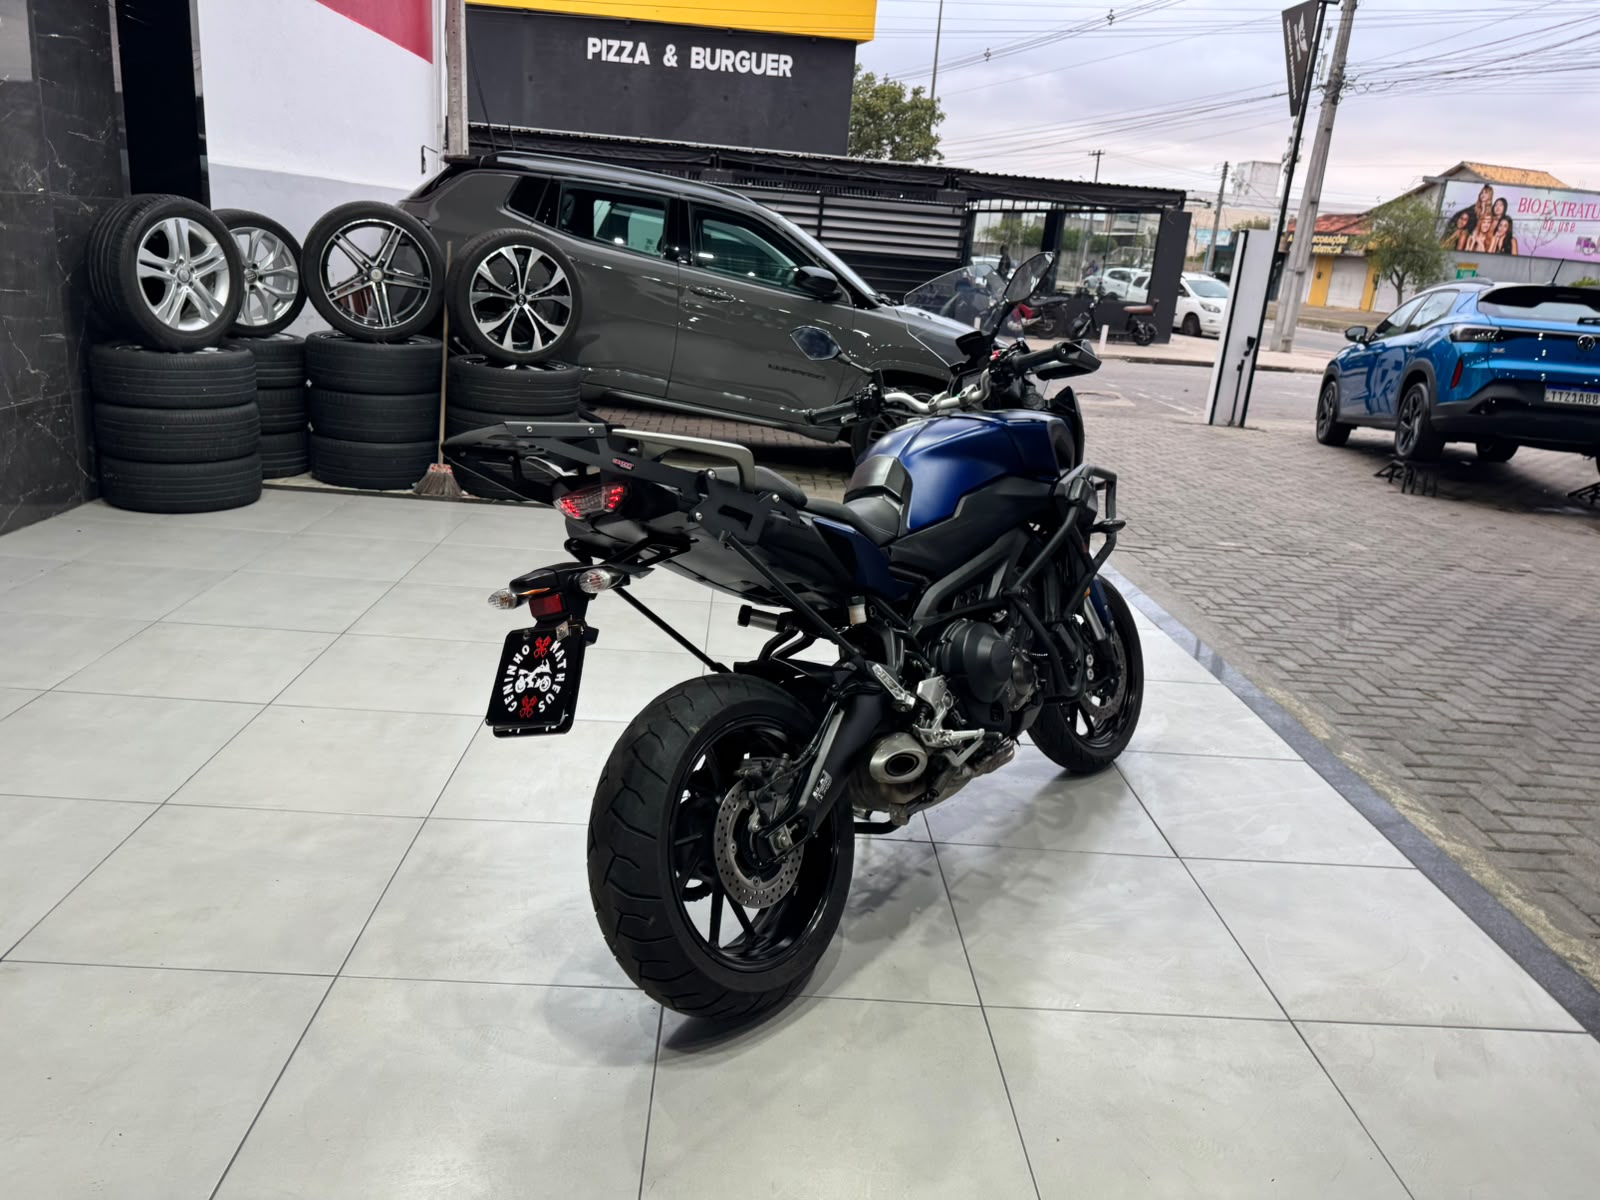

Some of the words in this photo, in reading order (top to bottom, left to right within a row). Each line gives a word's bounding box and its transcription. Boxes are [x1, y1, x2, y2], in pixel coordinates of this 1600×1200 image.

[587, 37, 650, 65] PIZZA
[663, 44, 678, 67] &
[690, 46, 793, 77] BURGUER
[1551, 390, 1599, 405] TTZ1A88
[502, 644, 530, 712] CENINHO
[538, 640, 567, 712] MATHEUS
